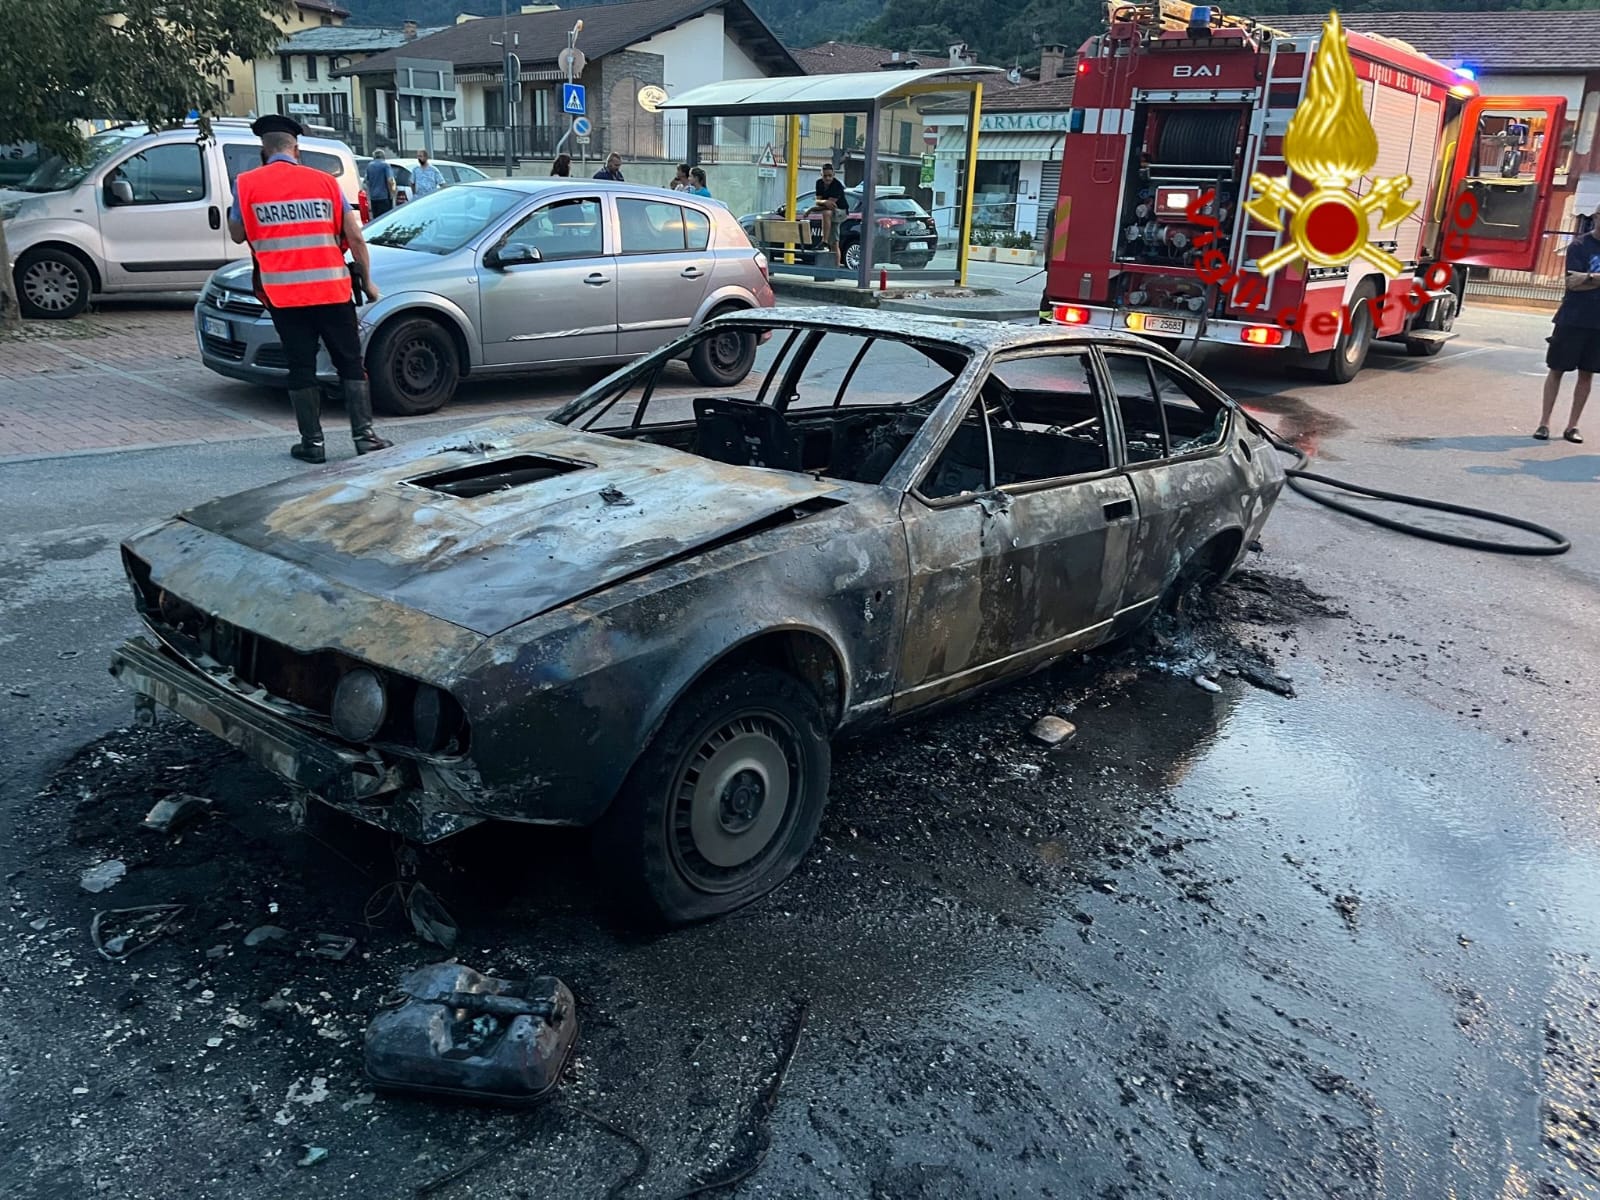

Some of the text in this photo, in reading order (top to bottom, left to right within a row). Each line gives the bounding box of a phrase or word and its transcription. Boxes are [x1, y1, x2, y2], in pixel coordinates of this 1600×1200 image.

[1173, 64, 1221, 77] BAI
[1369, 62, 1392, 83] VIGILI
[1396, 71, 1408, 89] DEL
[982, 115, 1068, 129] ARMACIA
